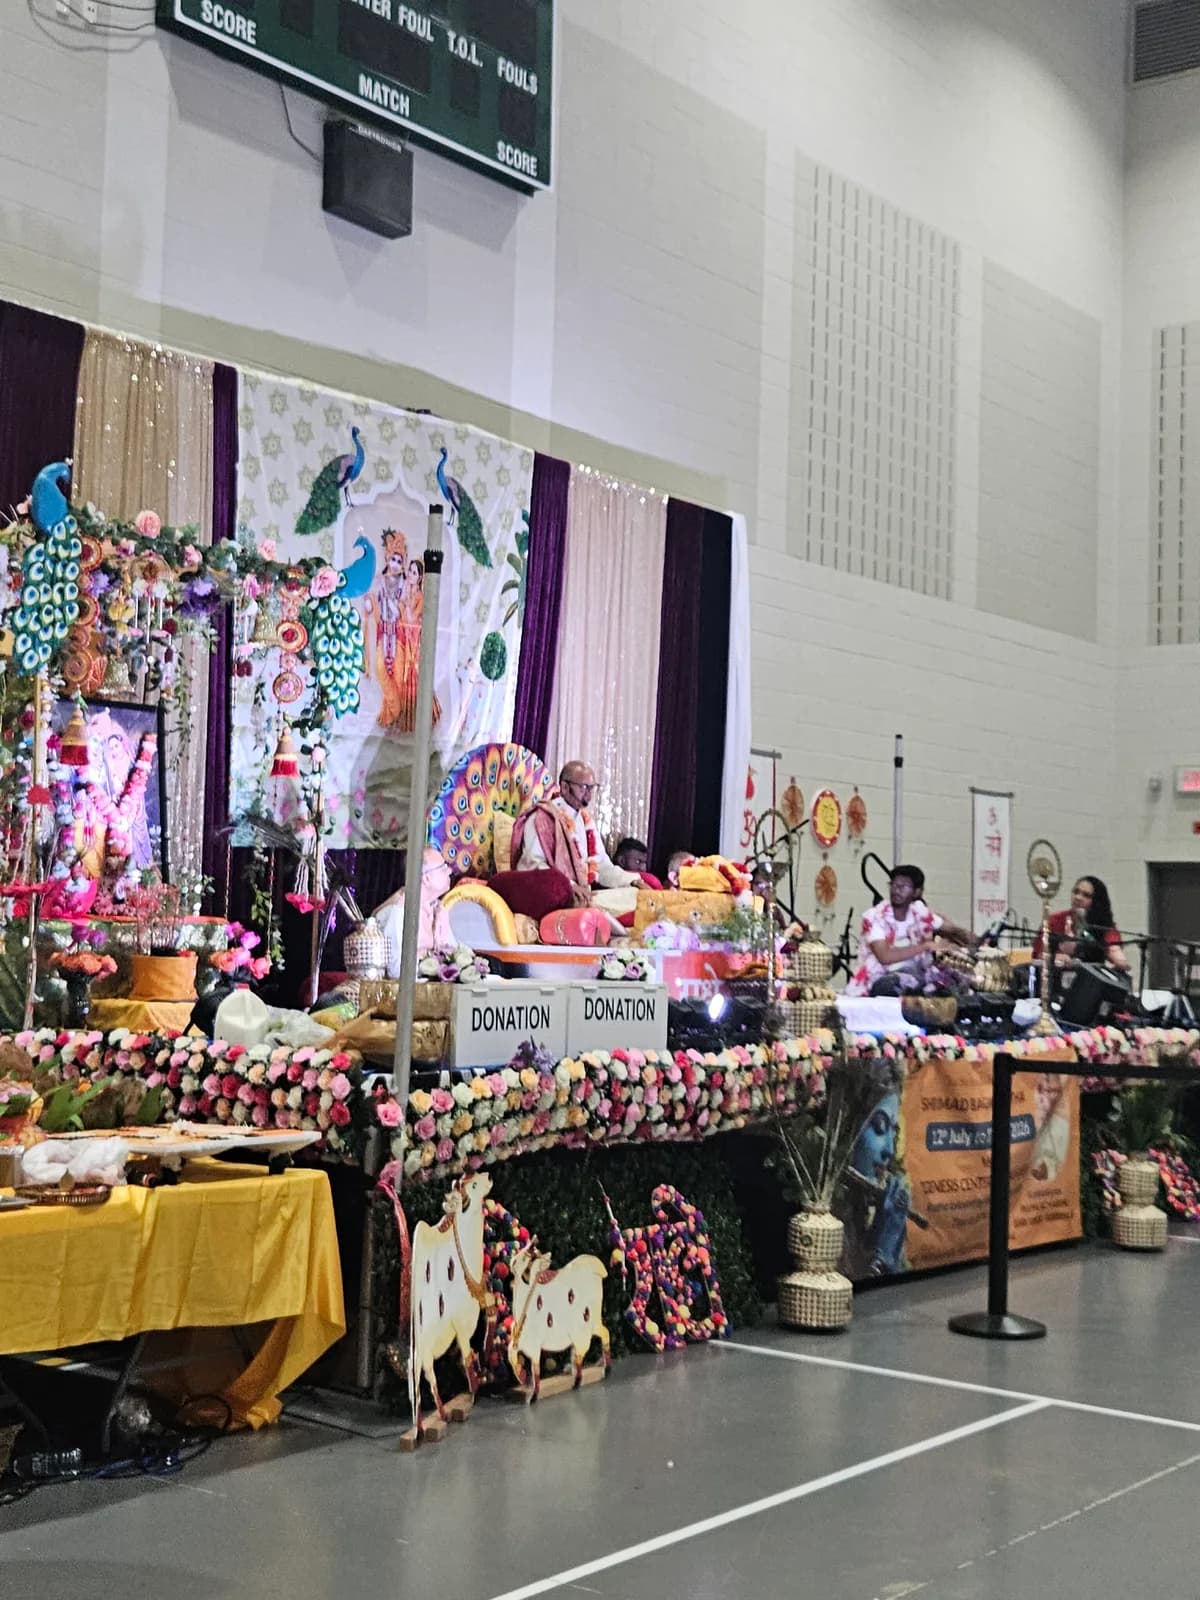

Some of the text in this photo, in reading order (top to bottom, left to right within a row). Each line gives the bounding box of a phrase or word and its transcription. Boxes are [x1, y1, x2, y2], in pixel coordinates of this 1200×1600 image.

[201, 0, 257, 46] SCORE
[398, 4, 435, 42] FOUL
[447, 30, 484, 67] T.O.L.
[497, 57, 538, 95] FOULS
[359, 74, 410, 117] MATCH
[497, 142, 538, 176] SCORE
[472, 1005, 550, 1032] DONATION
[585, 997, 655, 1021] DONATION
